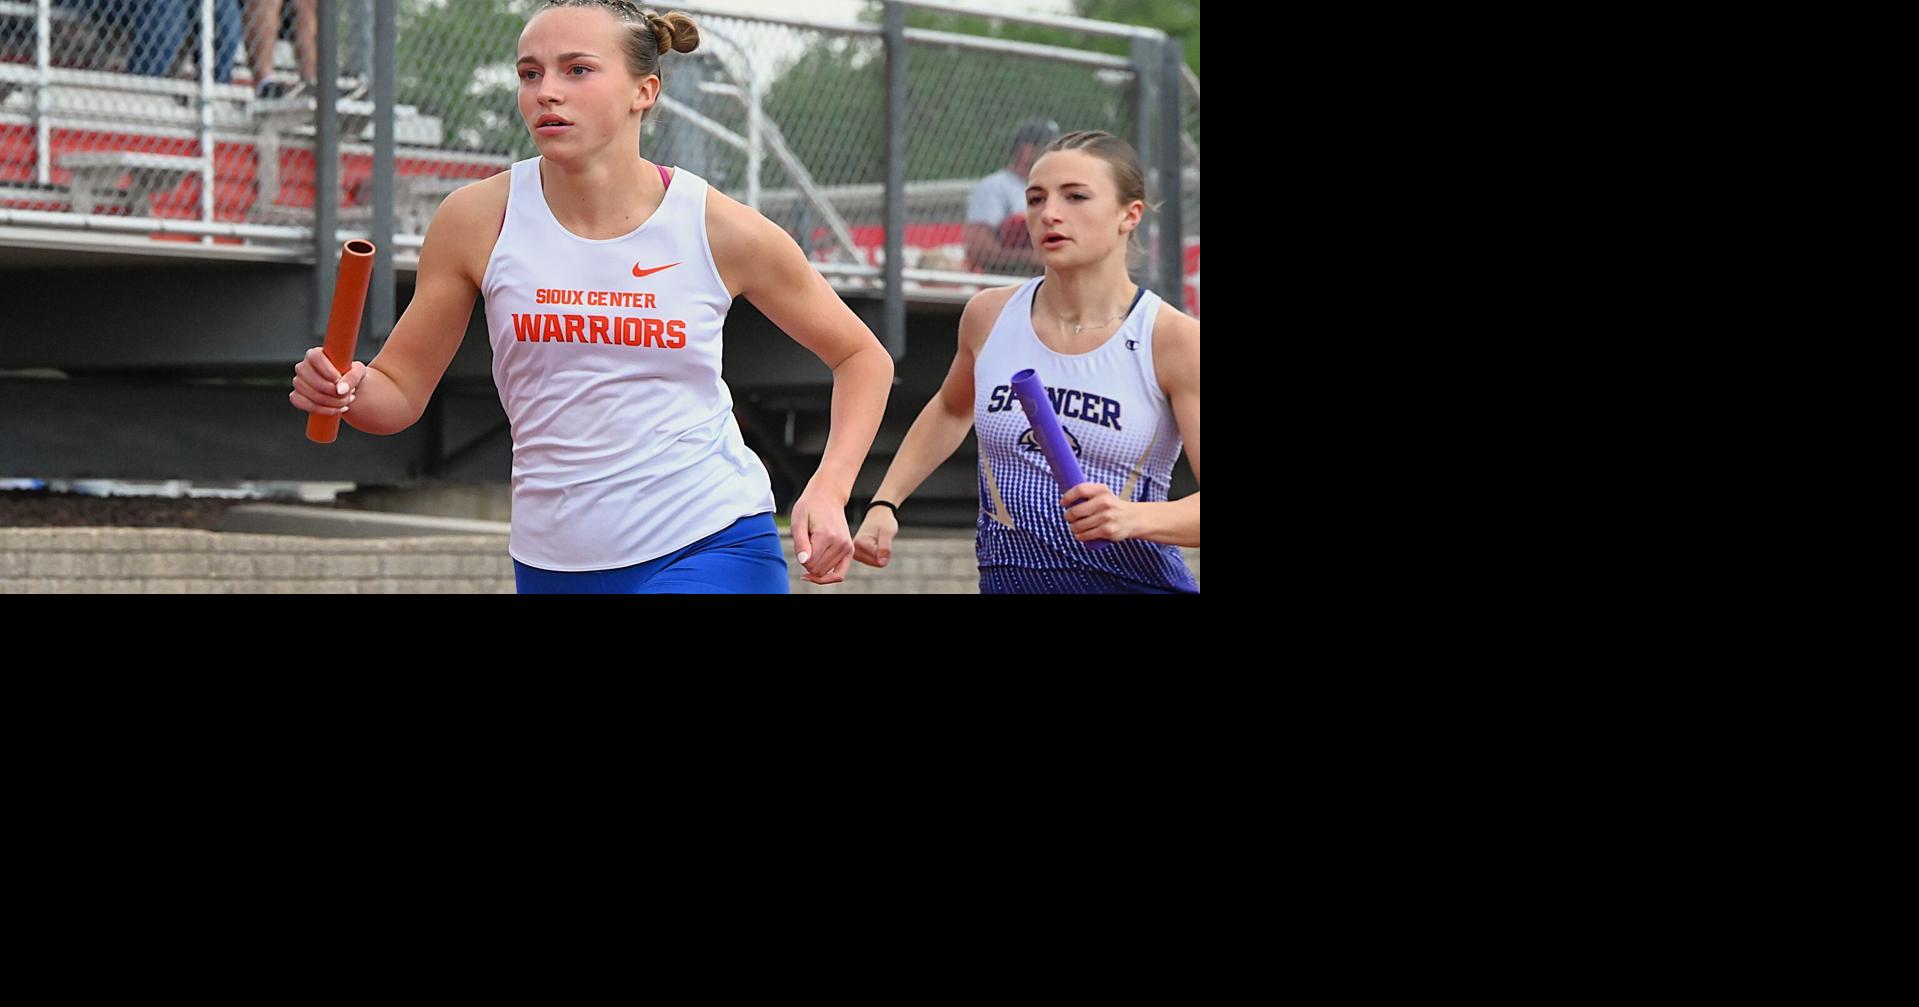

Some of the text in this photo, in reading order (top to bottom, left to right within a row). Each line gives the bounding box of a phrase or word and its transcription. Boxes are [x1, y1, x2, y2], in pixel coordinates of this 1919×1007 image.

[536, 288, 657, 308] SIOUX CENTER
[511, 313, 686, 349] WARRIORS
[987, 384, 1122, 431] SPNCER
